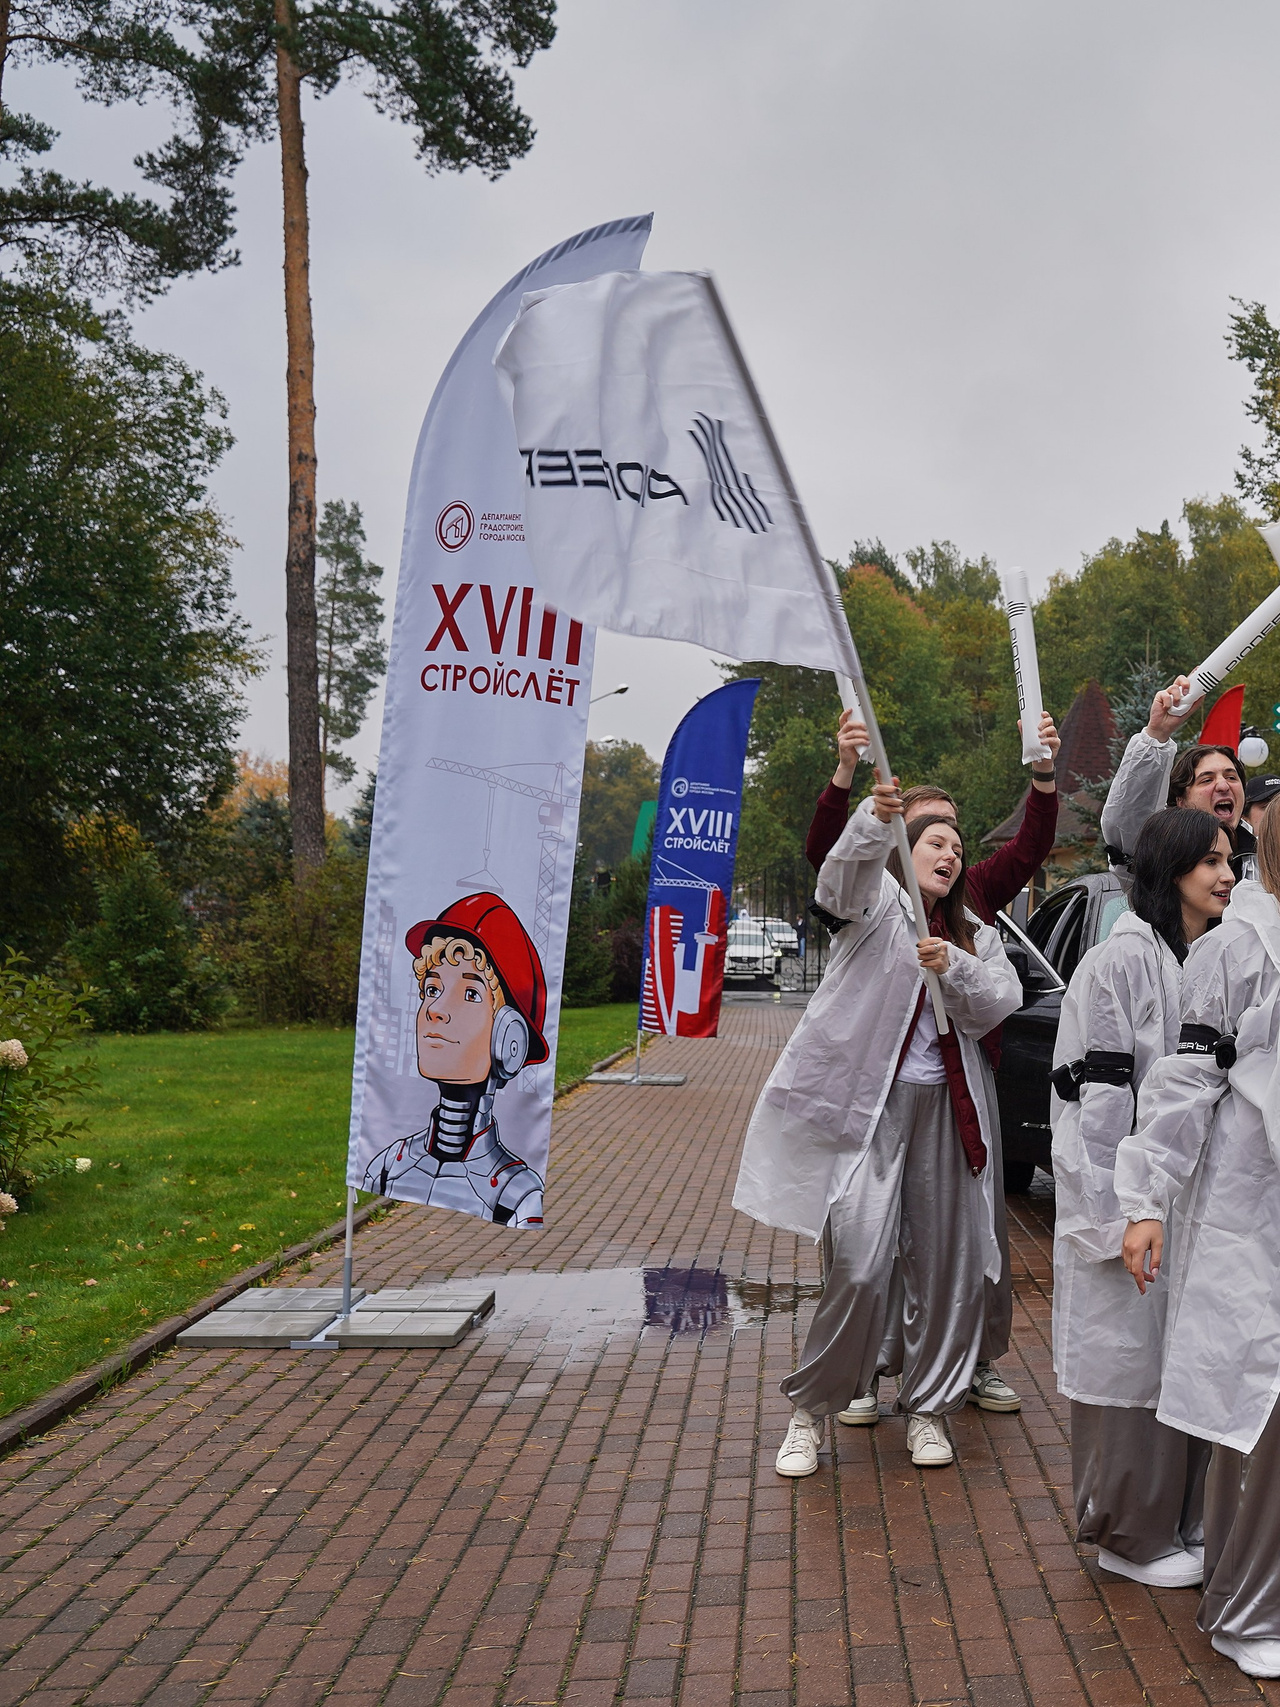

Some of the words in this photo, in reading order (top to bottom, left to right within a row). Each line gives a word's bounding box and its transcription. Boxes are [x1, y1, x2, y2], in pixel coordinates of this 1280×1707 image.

[480, 512, 522, 521] ДЕПАРТАМЕНТ
[479, 522, 525, 532] ГРАДОСТРОИТЕ
[479, 532, 506, 542] ГОРОДА
[506, 533, 526, 542] МОСКВ
[424, 583, 584, 666] XVIII
[420, 660, 581, 707] СТРОЙСЛЁТ
[666, 807, 733, 839] XVIII
[664, 836, 731, 854] СТРОЙСЛЁТ
